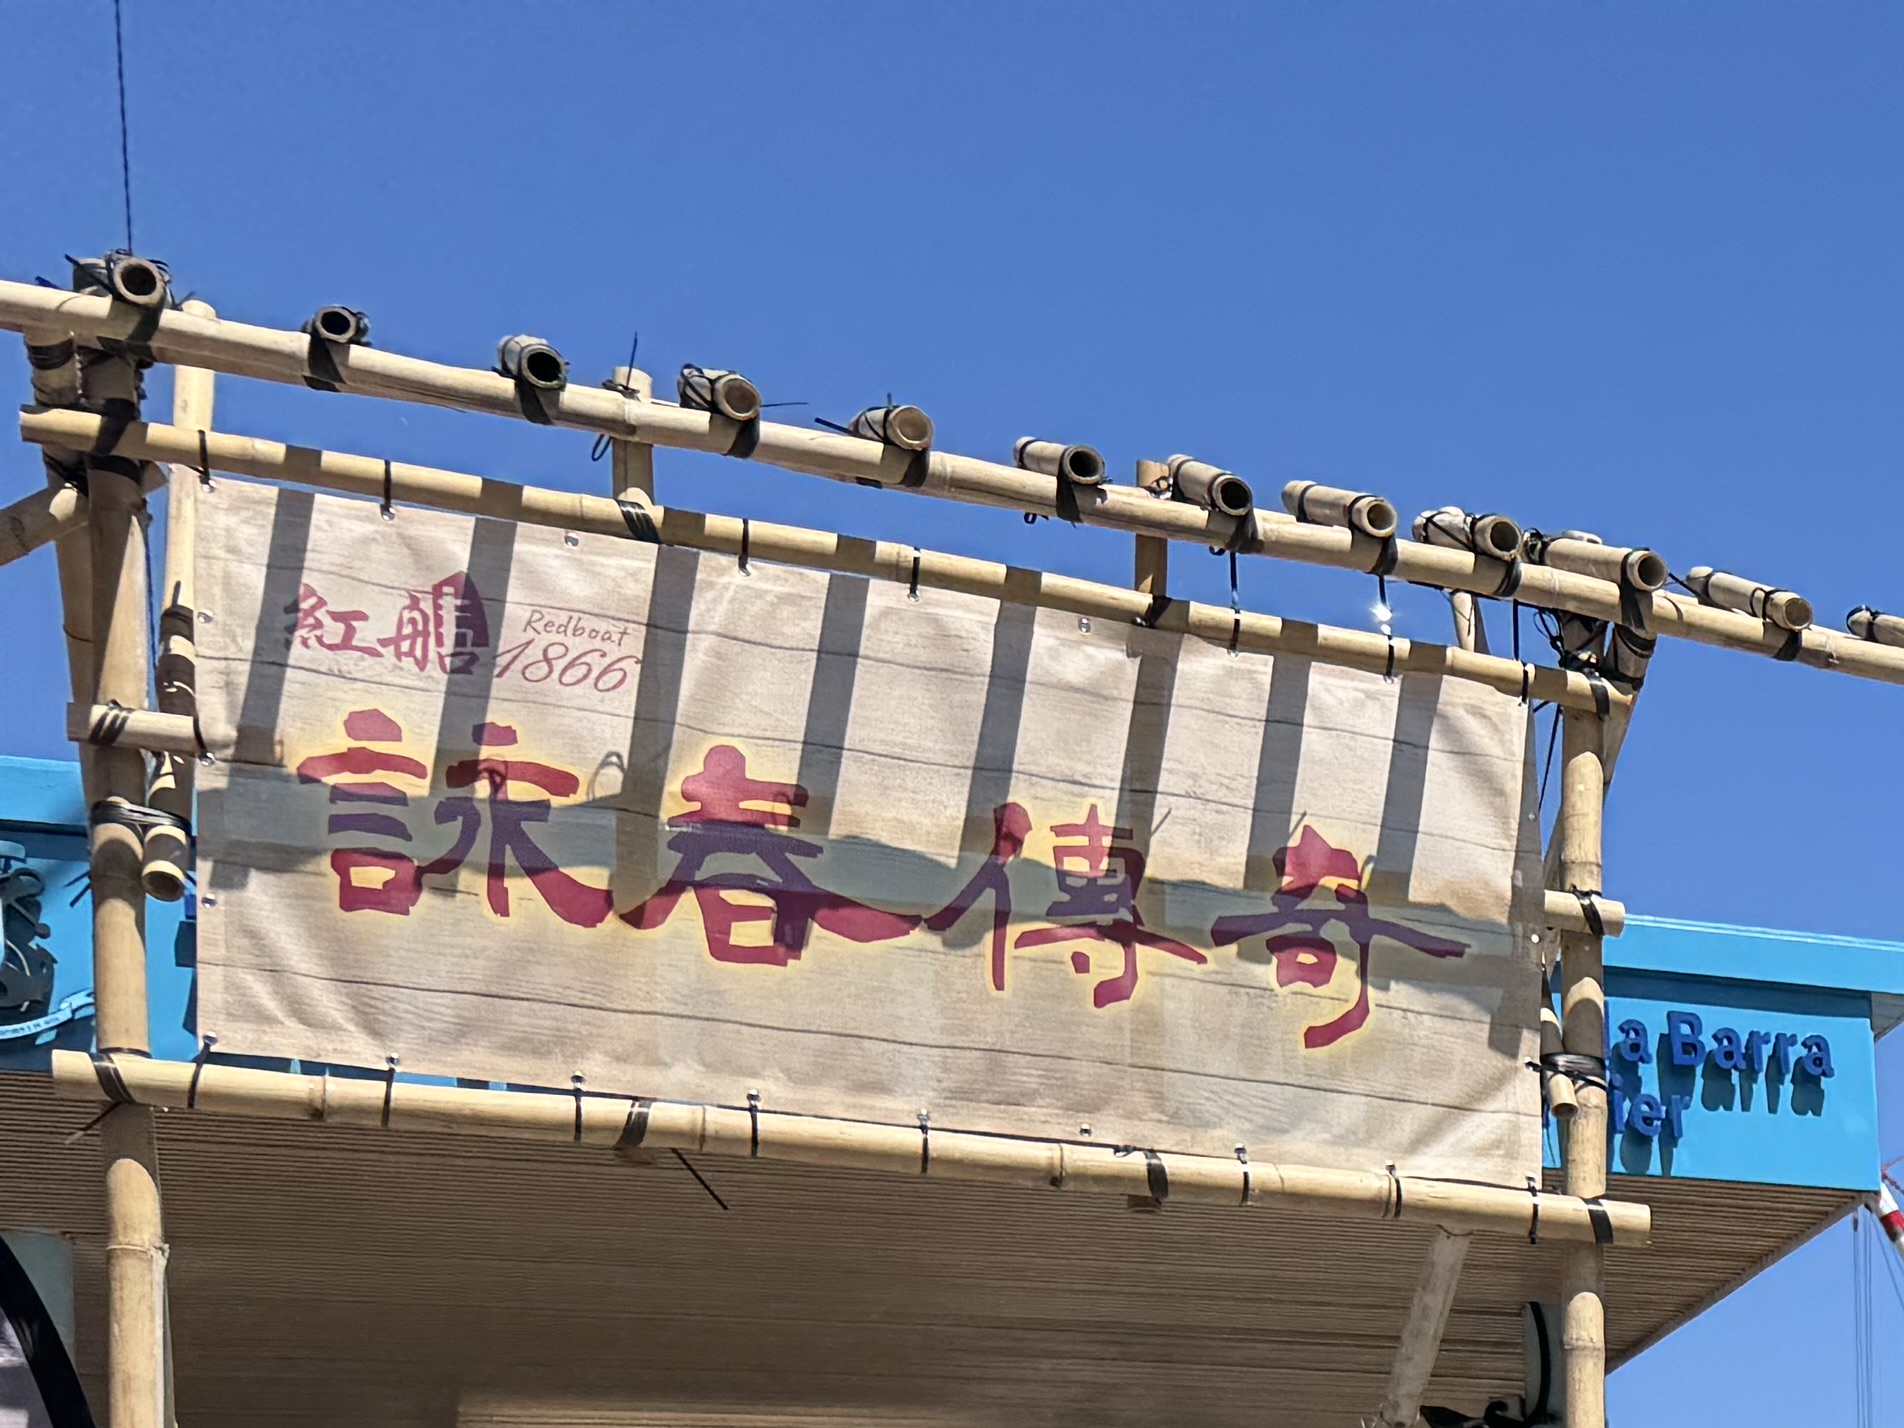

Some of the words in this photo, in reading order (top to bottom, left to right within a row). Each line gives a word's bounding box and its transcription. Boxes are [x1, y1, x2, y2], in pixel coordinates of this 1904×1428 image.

[523, 609, 631, 648] Redboat
[493, 638, 643, 693] 1866
[296, 707, 1471, 1049] 詠春傳奇
[1667, 1010, 1836, 1079] Barra
